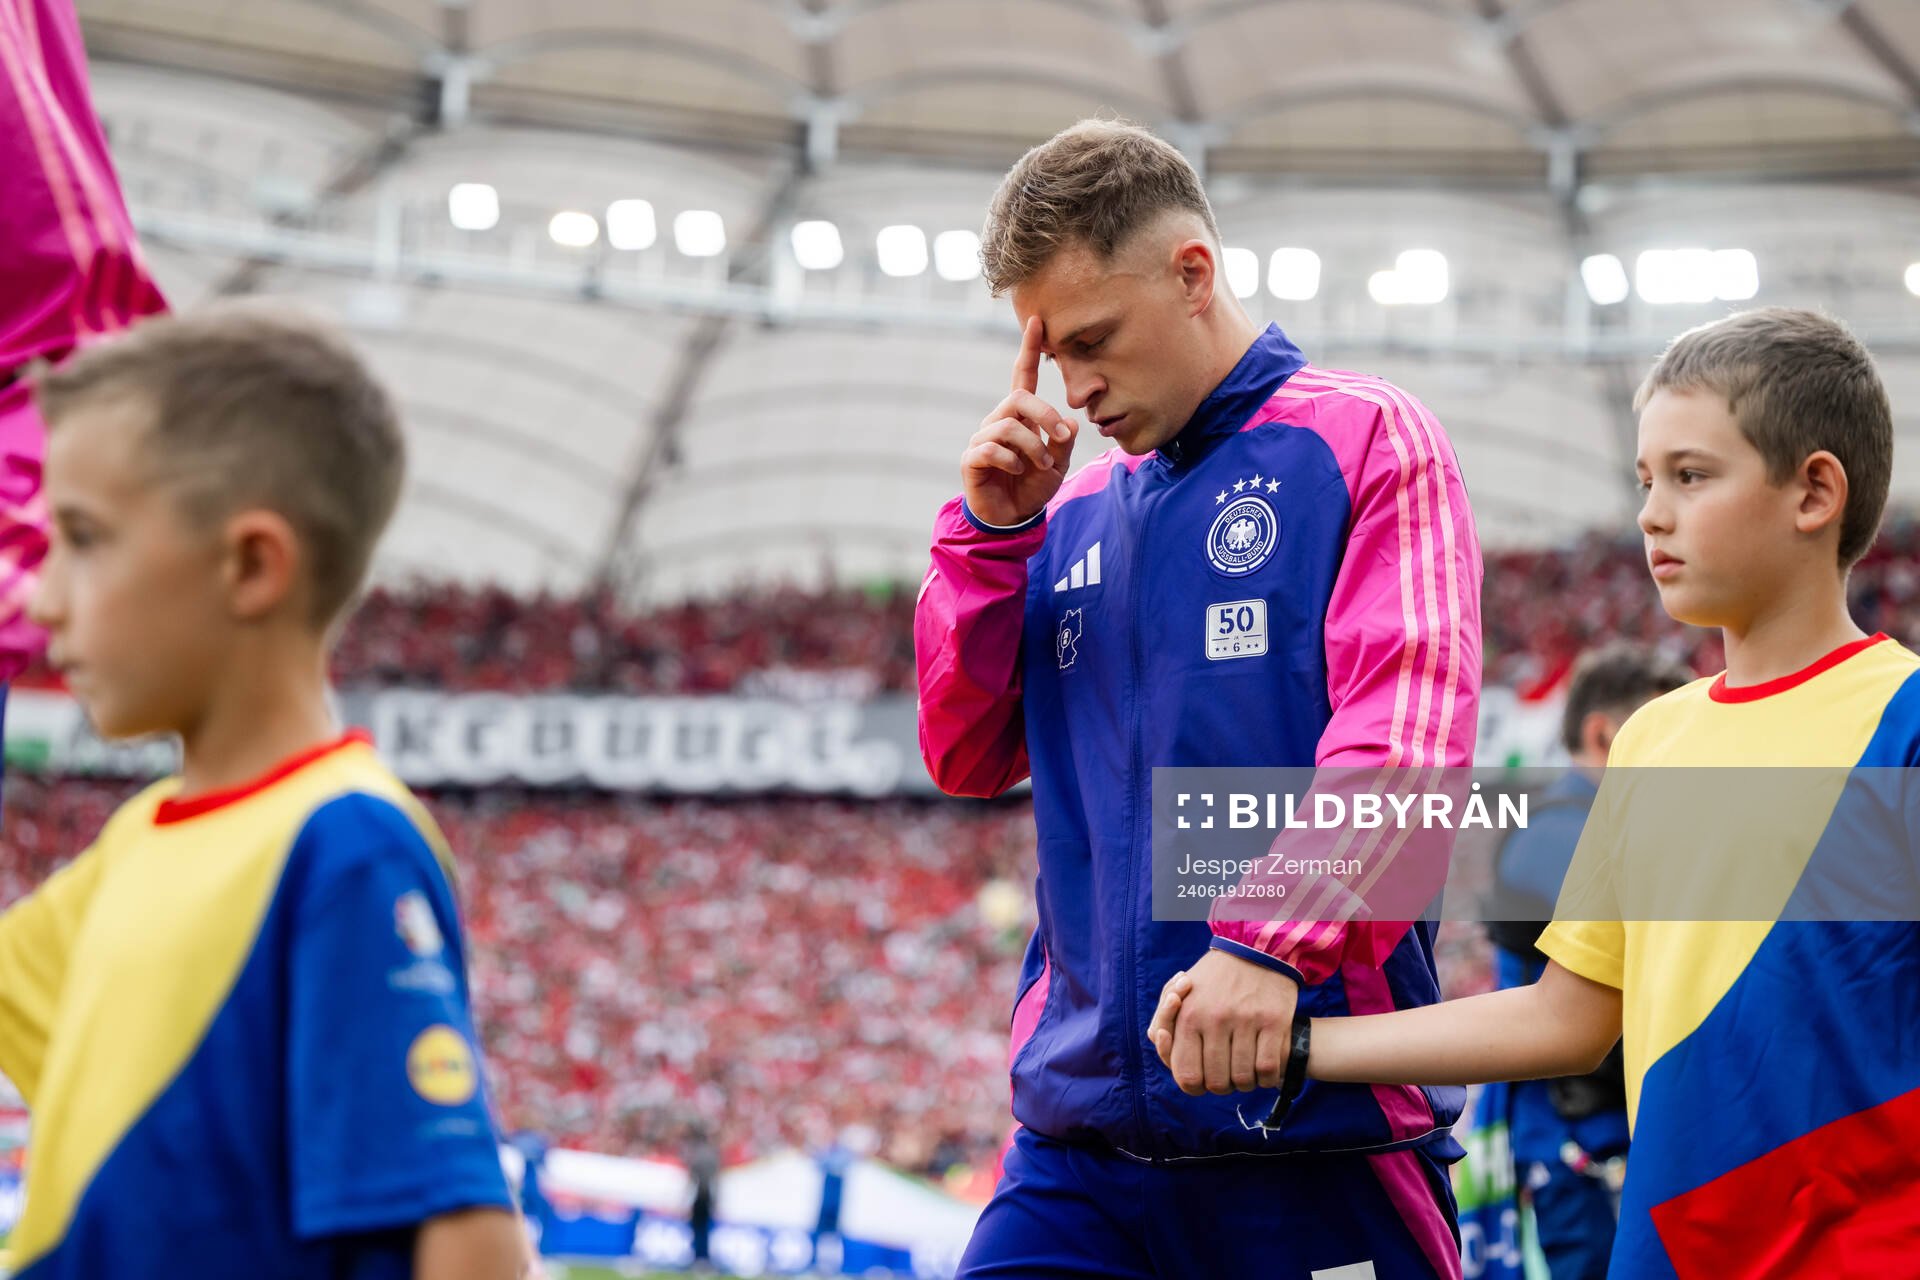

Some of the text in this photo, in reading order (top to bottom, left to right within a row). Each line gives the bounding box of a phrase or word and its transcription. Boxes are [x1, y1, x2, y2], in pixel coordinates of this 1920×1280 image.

[1224, 506, 1263, 525] DEUTSCHER
[1216, 540, 1264, 563] FUSSBALL-BUND
[1219, 605, 1254, 635] 50
[1233, 642, 1240, 653] 6
